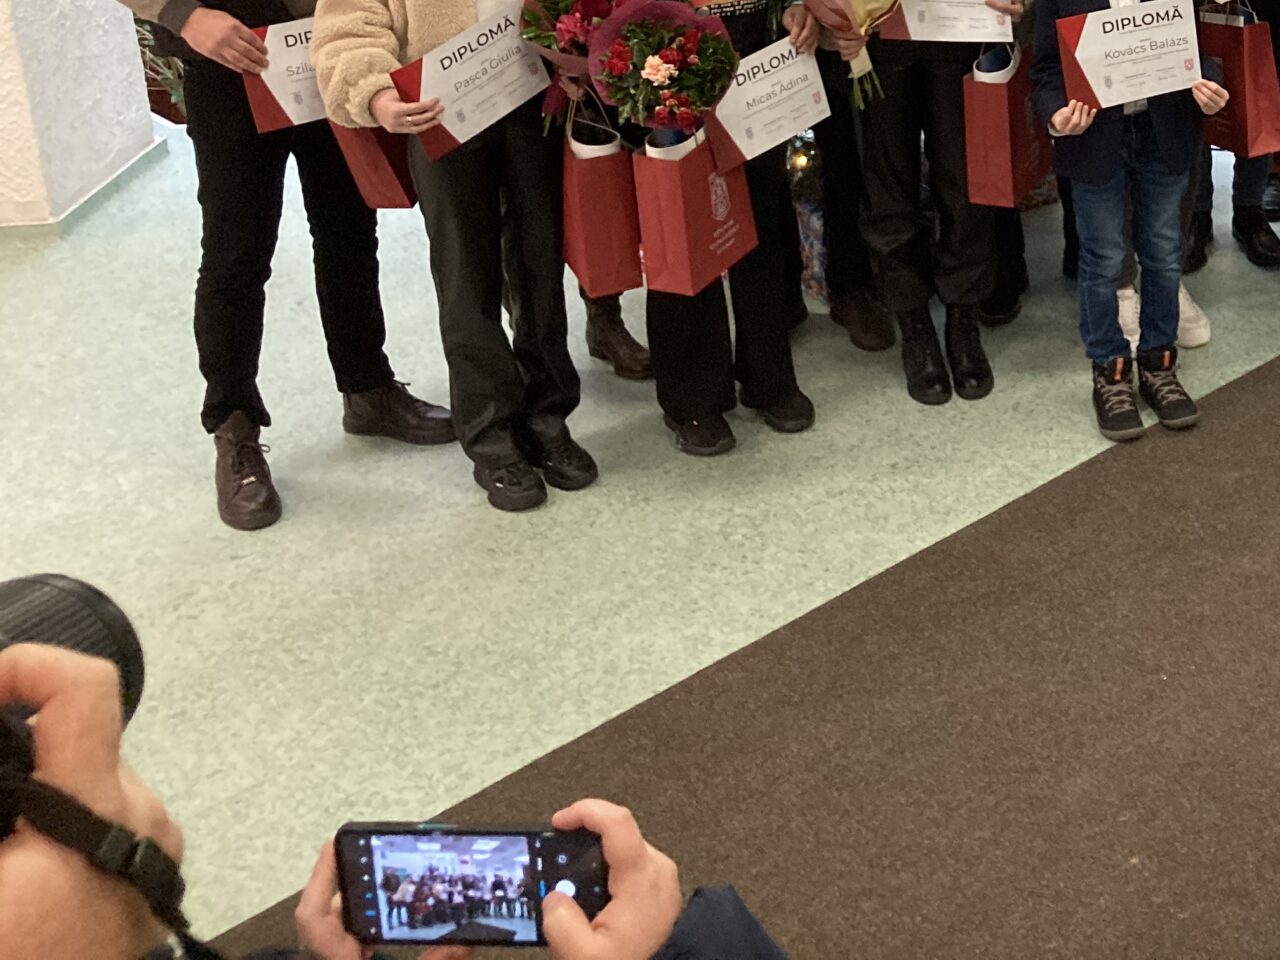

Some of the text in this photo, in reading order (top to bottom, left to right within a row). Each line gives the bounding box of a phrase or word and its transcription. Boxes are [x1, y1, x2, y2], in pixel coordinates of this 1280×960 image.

[1102, 5, 1183, 34] DIPLOMĂ
[440, 14, 516, 71] DIPLOMĂ
[1104, 36, 1189, 60] Kovács Balázs
[489, 45, 521, 70] Giulia
[780, 73, 809, 95] Adina
